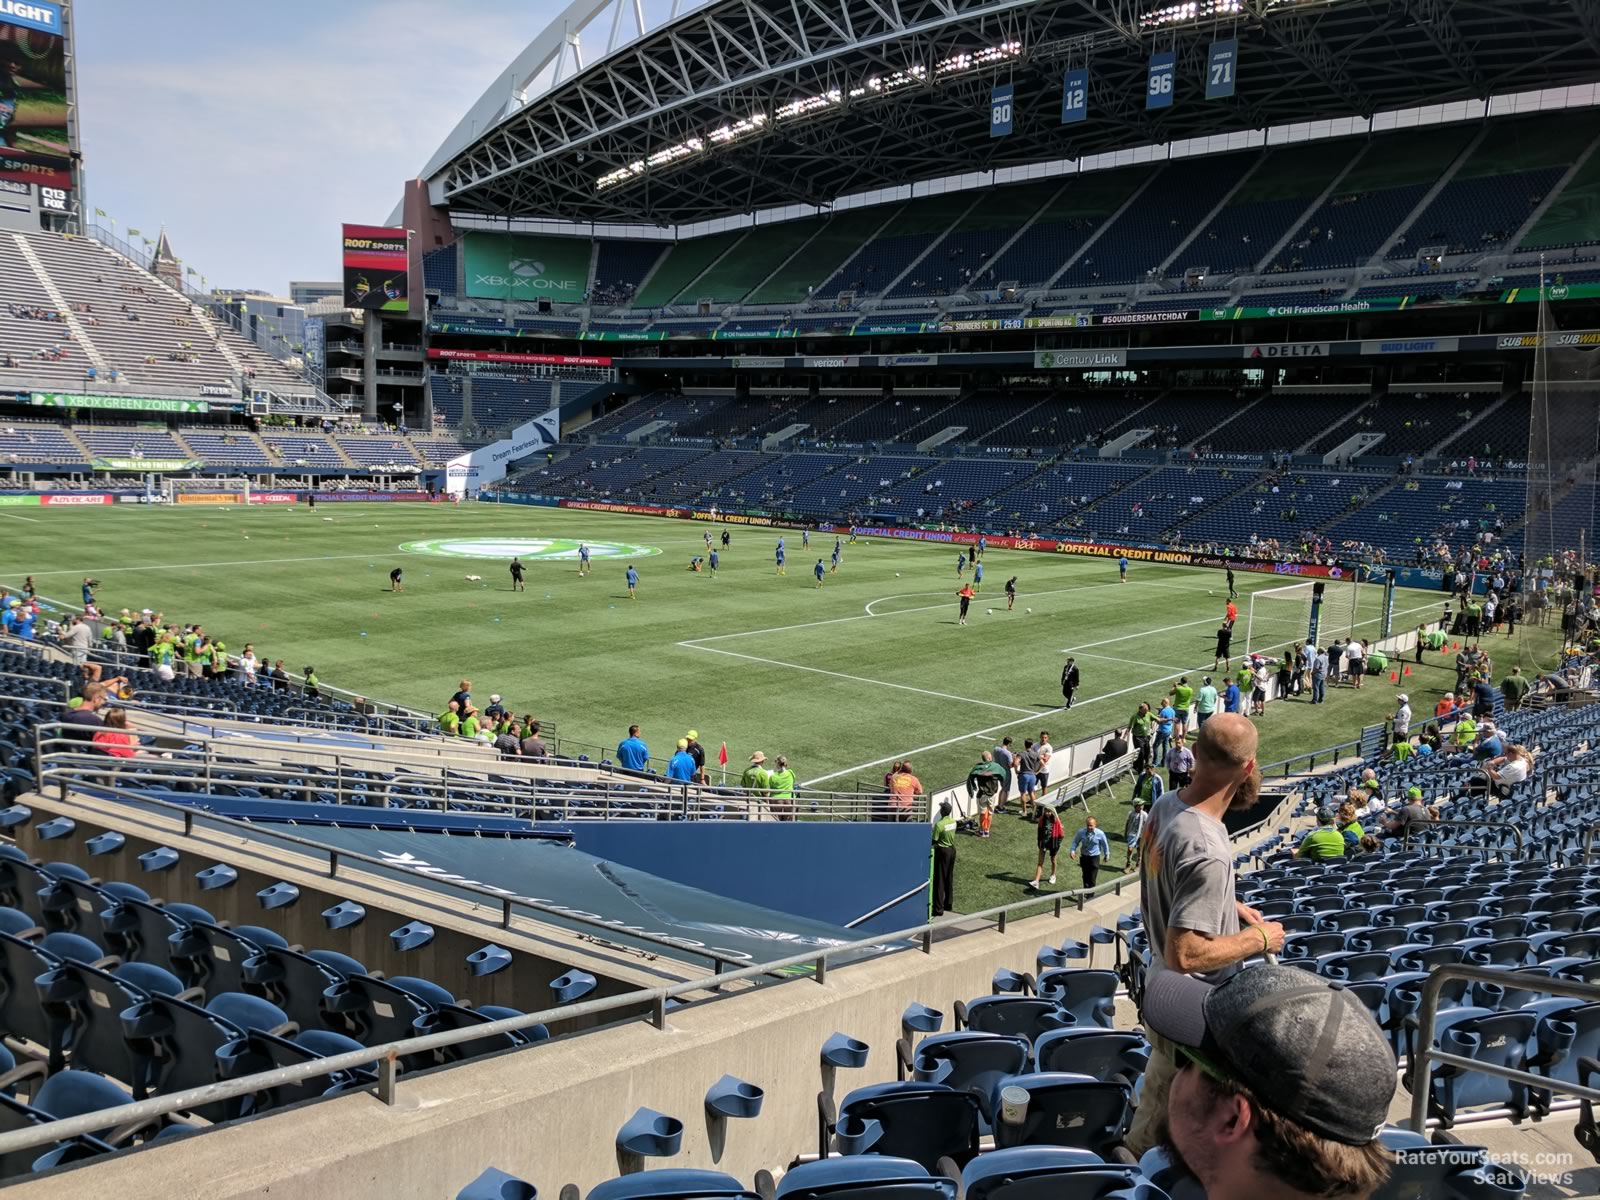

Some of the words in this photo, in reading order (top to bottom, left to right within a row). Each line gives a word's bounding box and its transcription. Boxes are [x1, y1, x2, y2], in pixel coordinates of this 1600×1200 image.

[1211, 62, 1231, 84] 71
[1149, 73, 1172, 95] 96
[1066, 89, 1084, 110] 12
[992, 104, 1011, 124] 80
[4, 160, 55, 177] SPORTS
[41, 187, 66, 200] Q13
[43, 198, 66, 209] FOX
[344, 238, 372, 249] ROOT
[372, 242, 404, 251] SPORTS
[475, 274, 530, 288] XBOX
[532, 279, 577, 290] ONE
[1278, 306, 1292, 315] CHI
[1294, 304, 1339, 314] Franciscan
[1341, 301, 1370, 311] Health
[955, 322, 981, 330] SOUNDERS
[1037, 318, 1064, 327] SPORTING
[1102, 312, 1188, 324] #SOUNDERSMATCHDAY
[1268, 344, 1321, 356] DELTA
[1404, 342, 1436, 351] LIGHT
[813, 358, 844, 367] verizon
[1056, 353, 1118, 366] CenturyLink
[69, 396, 101, 407] XBOX
[101, 397, 144, 409] GREEN
[145, 399, 177, 410] ZONE
[492, 450, 512, 462] Dream
[512, 438, 539, 453] Fearlessly
[567, 501, 590, 509] OFFICIAL
[590, 503, 610, 511] CREDIT
[610, 504, 628, 513] UNION
[725, 514, 749, 524] CREDIT
[750, 516, 772, 526] UNION
[857, 527, 892, 537] OFFICIAL
[893, 529, 924, 539] CREDIT
[925, 532, 953, 541] UNION
[1065, 544, 1111, 556] OFFICIAL
[1112, 548, 1153, 560] CREDIT
[1154, 551, 1192, 563] UNION
